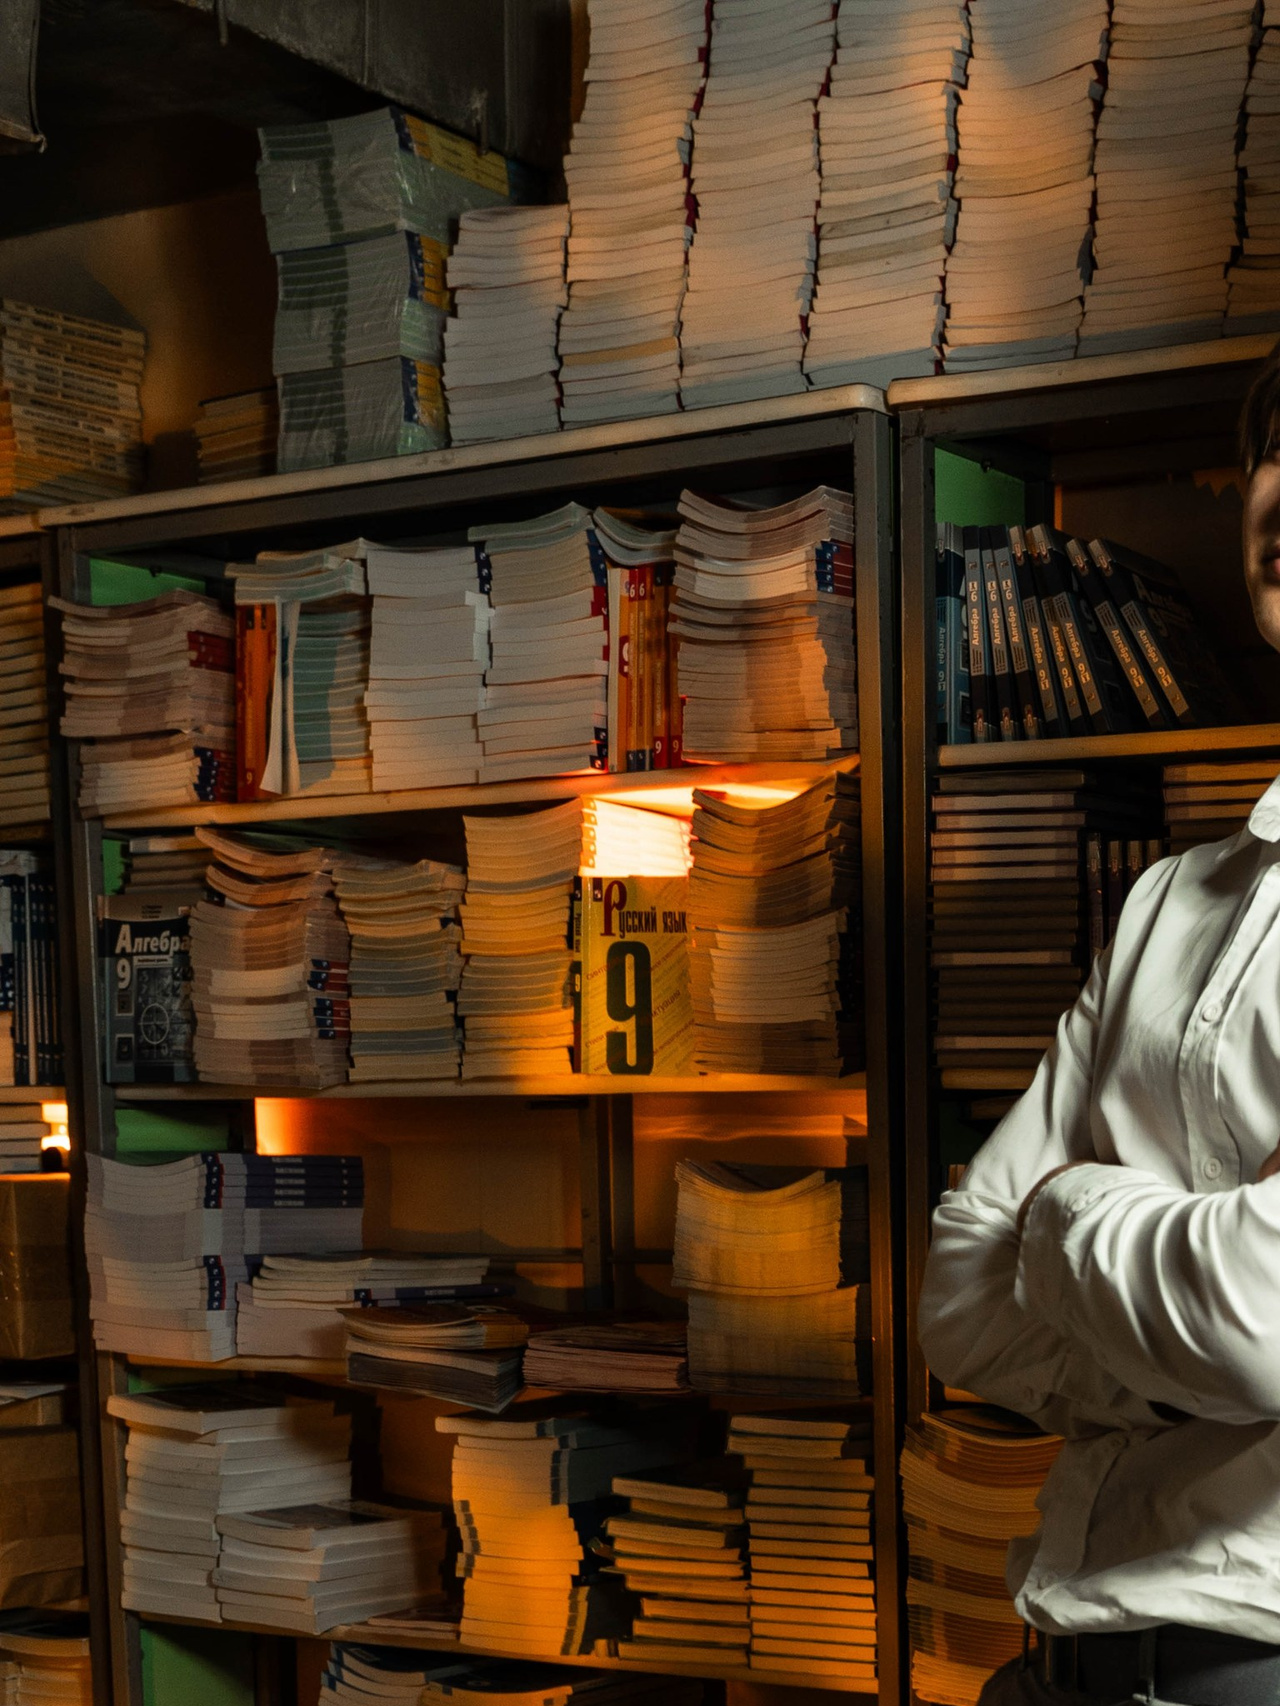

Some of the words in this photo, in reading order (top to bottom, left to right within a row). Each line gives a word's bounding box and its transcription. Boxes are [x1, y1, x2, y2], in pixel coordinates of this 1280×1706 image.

[1031, 627, 1044, 664] Алгебра
[1052, 626, 1065, 662] Алгебра
[1065, 622, 1081, 659] Алгебра
[1111, 629, 1131, 664] Алгебра
[1138, 629, 1159, 662] Алгебра
[654, 740, 662, 754] 9
[600, 880, 657, 939] Русский
[662, 911, 688, 934] язык
[117, 958, 132, 990] 9
[606, 940, 654, 1076] 9
